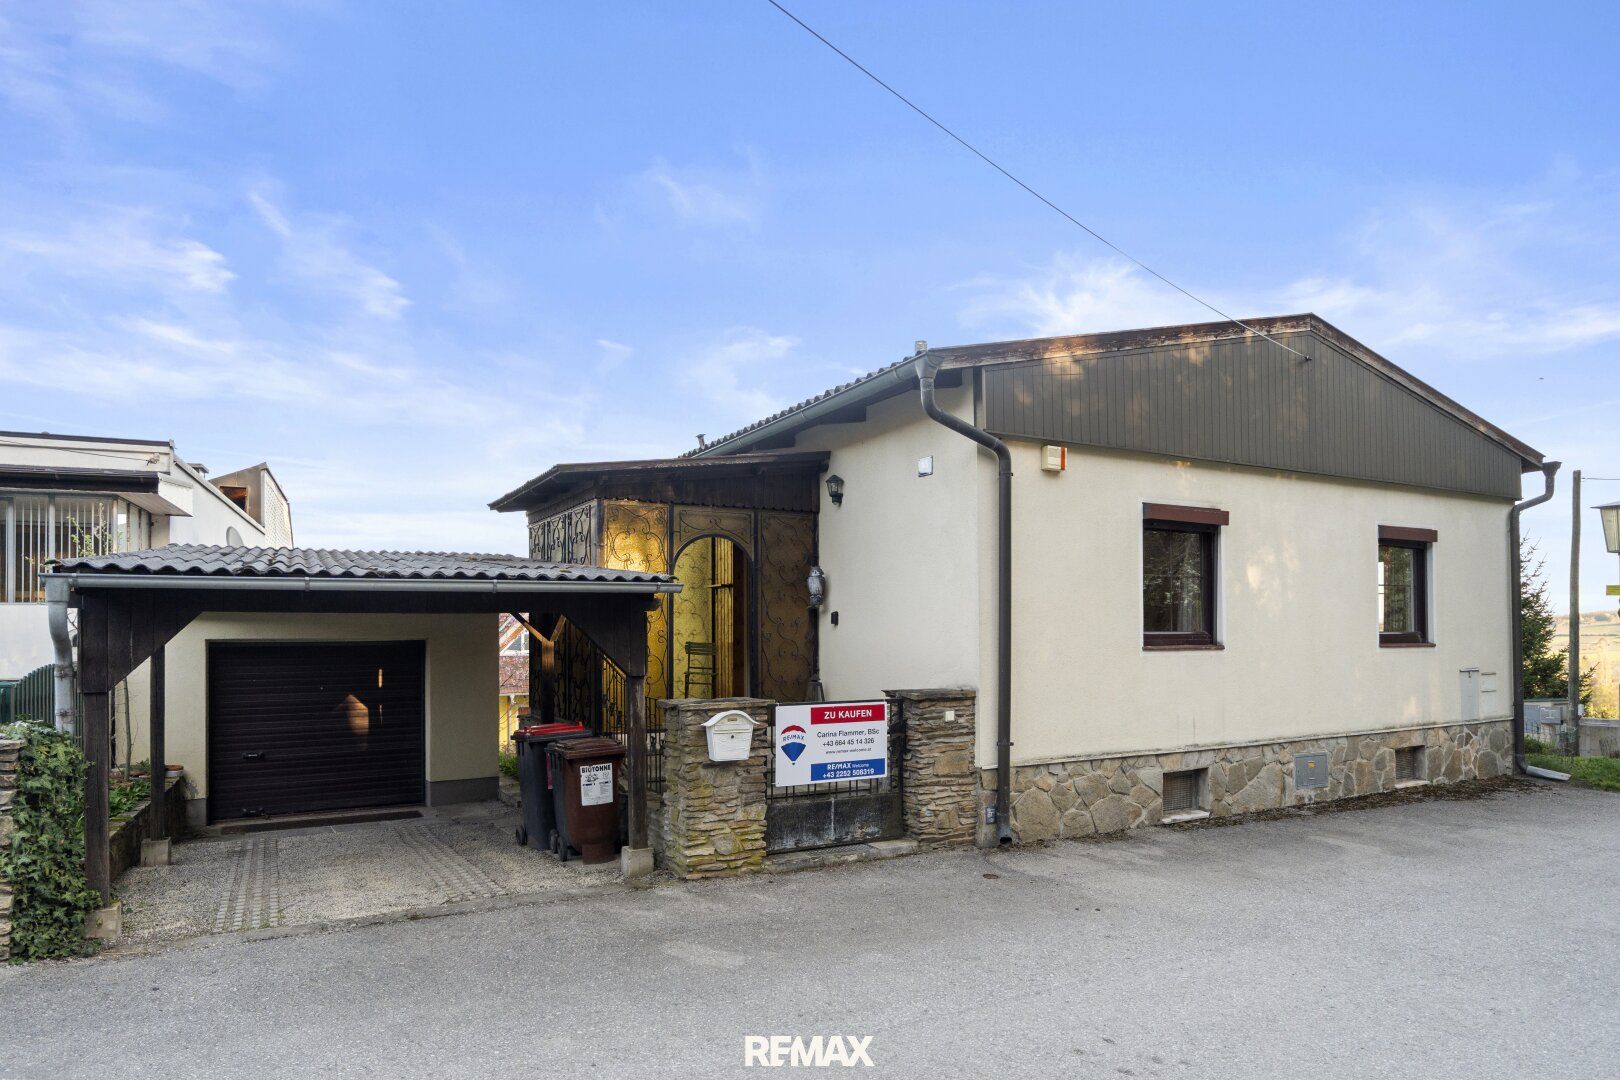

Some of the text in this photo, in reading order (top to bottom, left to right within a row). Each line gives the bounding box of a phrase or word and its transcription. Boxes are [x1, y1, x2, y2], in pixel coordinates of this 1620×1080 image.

[824, 709, 872, 720] ZU KAUFEN
[581, 765, 611, 773] BIOTONNE
[836, 770, 851, 778] 2252
[852, 768, 875, 776] 508319
